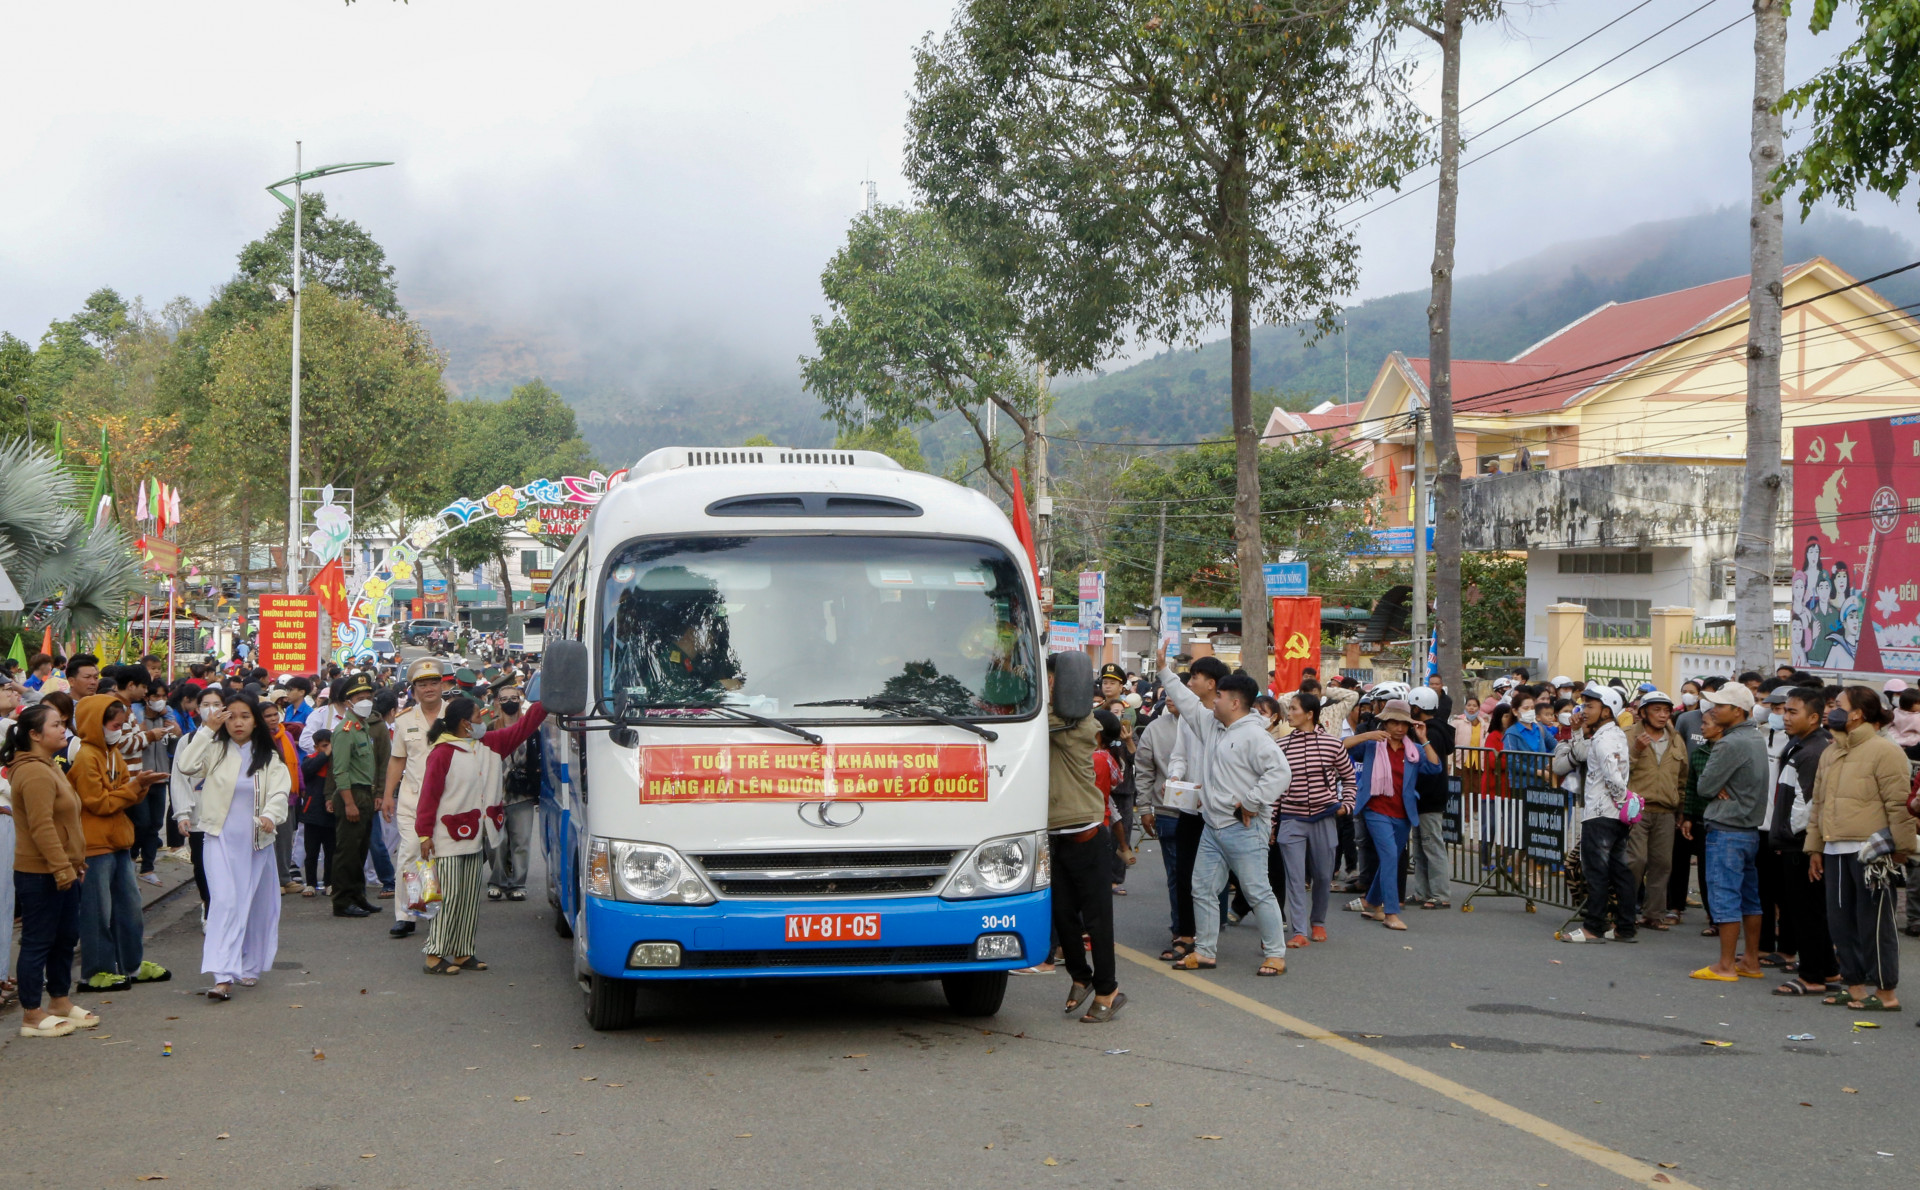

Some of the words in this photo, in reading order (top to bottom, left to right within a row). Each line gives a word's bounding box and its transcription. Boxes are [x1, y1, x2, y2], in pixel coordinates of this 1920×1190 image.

[272, 599, 288, 607] CHÀO
[290, 599, 308, 607] MỪNG
[263, 609, 284, 617] NHỮNG
[275, 620, 291, 628] THÂN
[293, 620, 304, 628] YÊU
[273, 630, 285, 639] CỦA
[286, 631, 306, 640] HUYỆN
[272, 641, 293, 650] KHÁNH
[294, 642, 307, 650] SƠN
[272, 652, 285, 660] LÊN
[285, 653, 306, 661] ĐƯỜNG
[274, 663, 290, 672] NHẬP
[292, 663, 305, 671] NGŨ
[692, 749, 732, 769] TUỔI
[737, 750, 769, 769] TRẺ
[775, 754, 835, 772] HUYỆN
[838, 752, 899, 769] KHÁNH
[903, 752, 939, 769] SƠN
[650, 777, 699, 795] HĂNG
[704, 776, 734, 794] HÁI
[739, 776, 773, 794] LÊN
[777, 775, 839, 794] ĐƯỜNG
[844, 773, 879, 793] BẢO
[883, 775, 904, 796] VỆ
[908, 773, 930, 793] TỔ
[934, 773, 979, 794] QUỐC
[1539, 812, 1549, 832] VỰC
[1550, 809, 1562, 831] CẤM
[981, 914, 1016, 928] 30-01
[788, 915, 878, 938] KV-81-05
